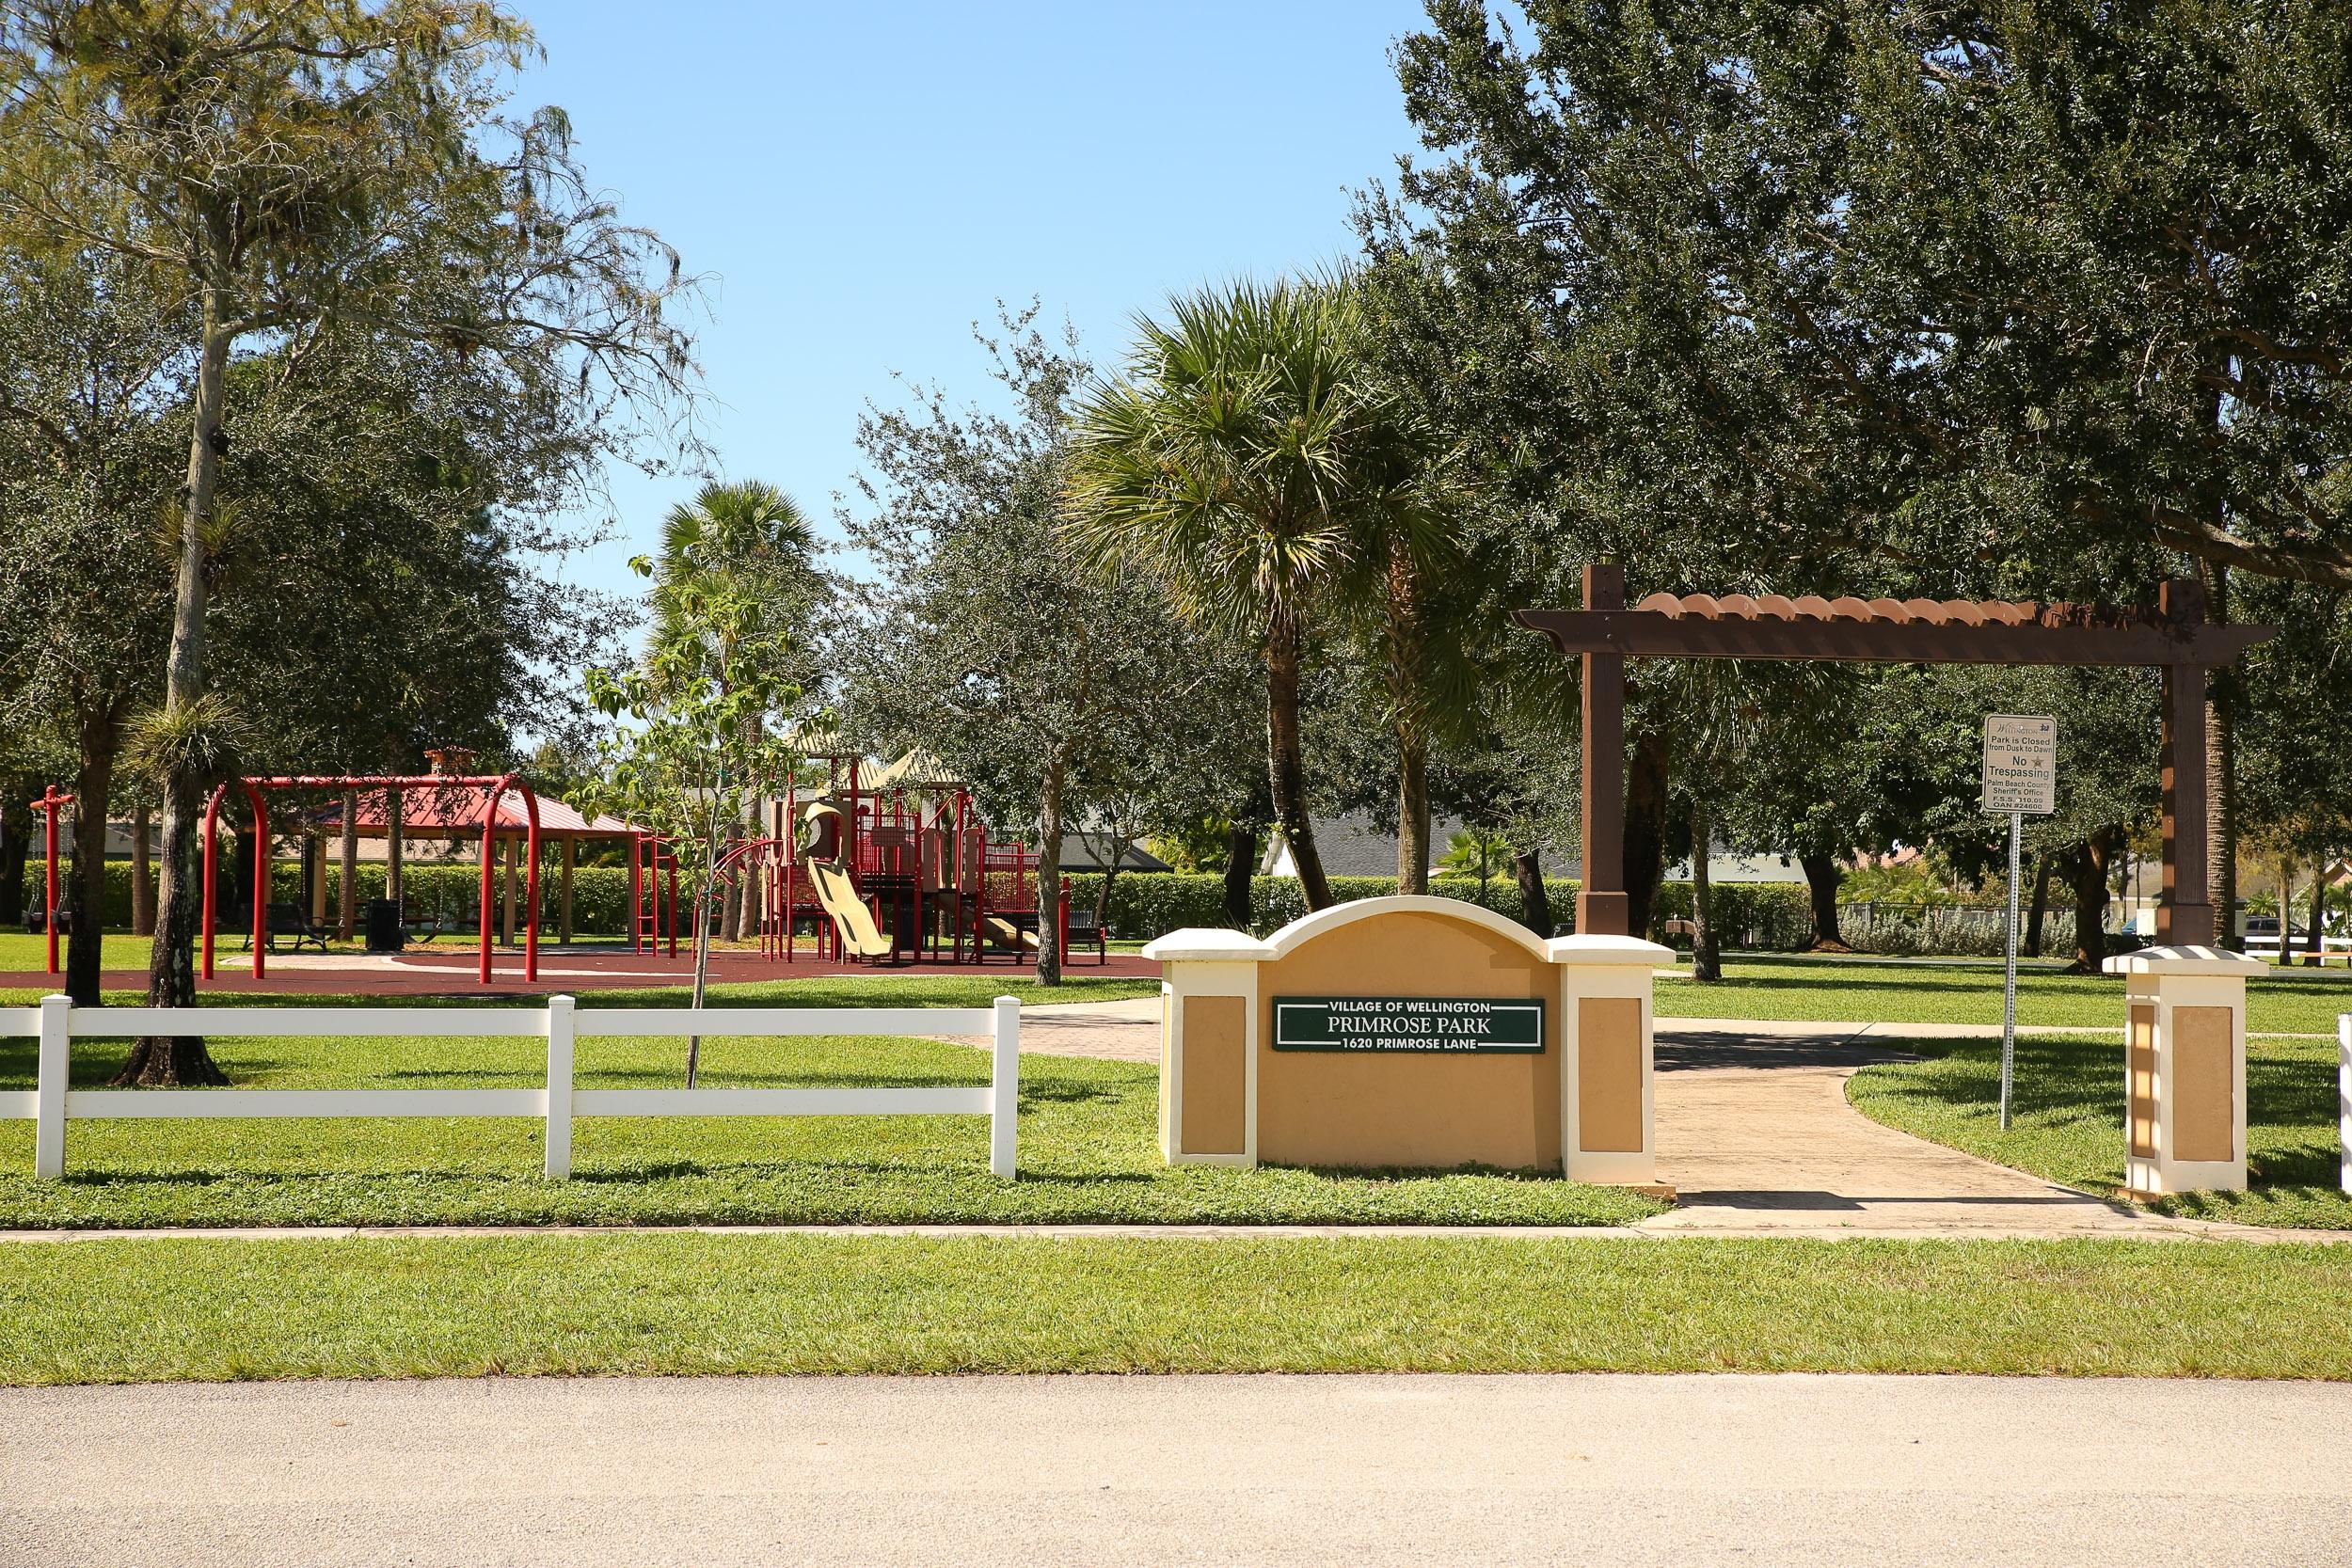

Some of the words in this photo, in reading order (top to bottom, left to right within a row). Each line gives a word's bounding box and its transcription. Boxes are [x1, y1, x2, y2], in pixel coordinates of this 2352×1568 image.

[1992, 736, 2010, 744] Park
[2022, 737, 2050, 746] Closed
[1989, 743, 2005, 752] from
[2007, 744, 2024, 752] Dusk
[2012, 755, 2027, 766] No
[1989, 766, 2049, 781] Trespassing
[2027, 781, 2050, 789] County
[1328, 1001, 1382, 1012] VILLAGE
[1385, 1002, 1403, 1013] OF
[1406, 1002, 1490, 1013] WELLINGTON
[1327, 1016, 1432, 1034] PRIMROSE
[1437, 1017, 1491, 1035] PARK
[1342, 1037, 1373, 1049] 1620
[1376, 1037, 1440, 1049] PRIMROSE
[1444, 1038, 1476, 1050] LANE
